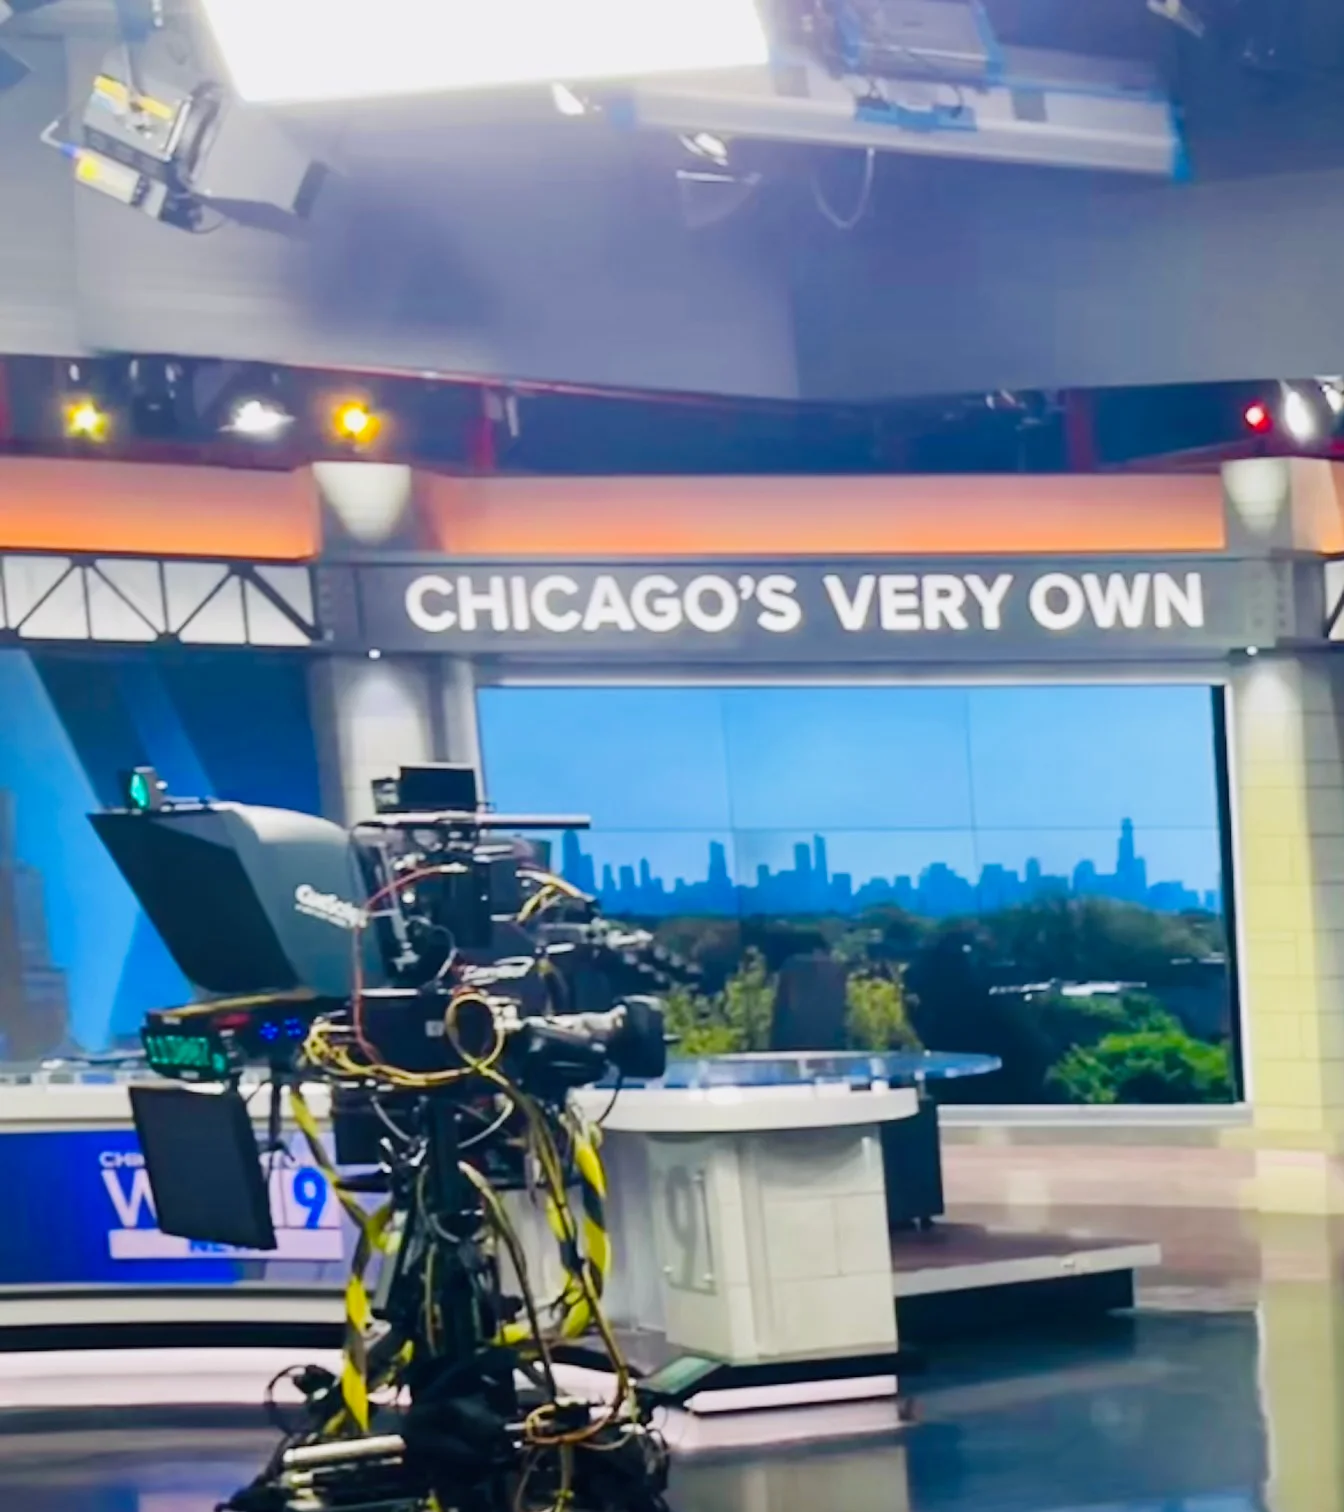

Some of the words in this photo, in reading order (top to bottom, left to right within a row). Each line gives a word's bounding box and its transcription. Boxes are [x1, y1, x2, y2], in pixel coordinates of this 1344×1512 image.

[405, 575, 802, 634] CHICAGO'S
[823, 574, 1013, 631] VERY
[1029, 572, 1204, 630] OWN
